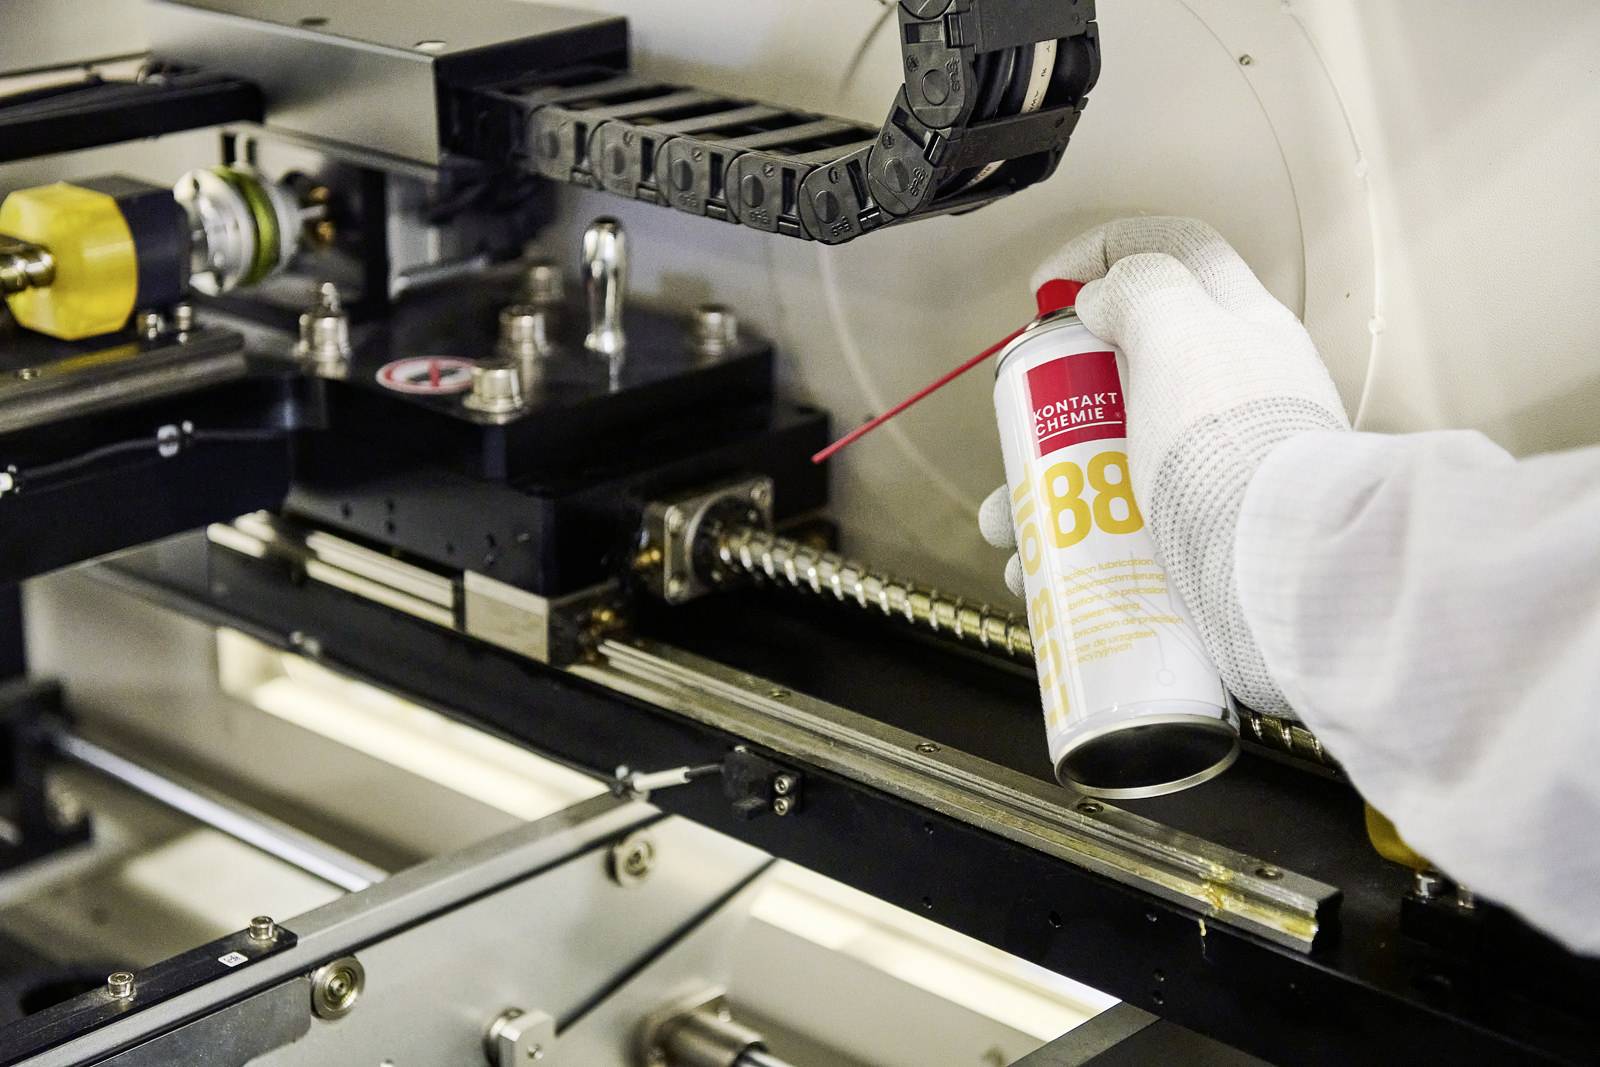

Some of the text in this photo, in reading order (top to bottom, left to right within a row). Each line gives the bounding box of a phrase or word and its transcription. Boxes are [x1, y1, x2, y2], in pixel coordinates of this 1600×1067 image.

[1033, 392, 1118, 424] KONTAKT
[1035, 407, 1105, 437] CHEMIE
[1041, 450, 1145, 549] 88
